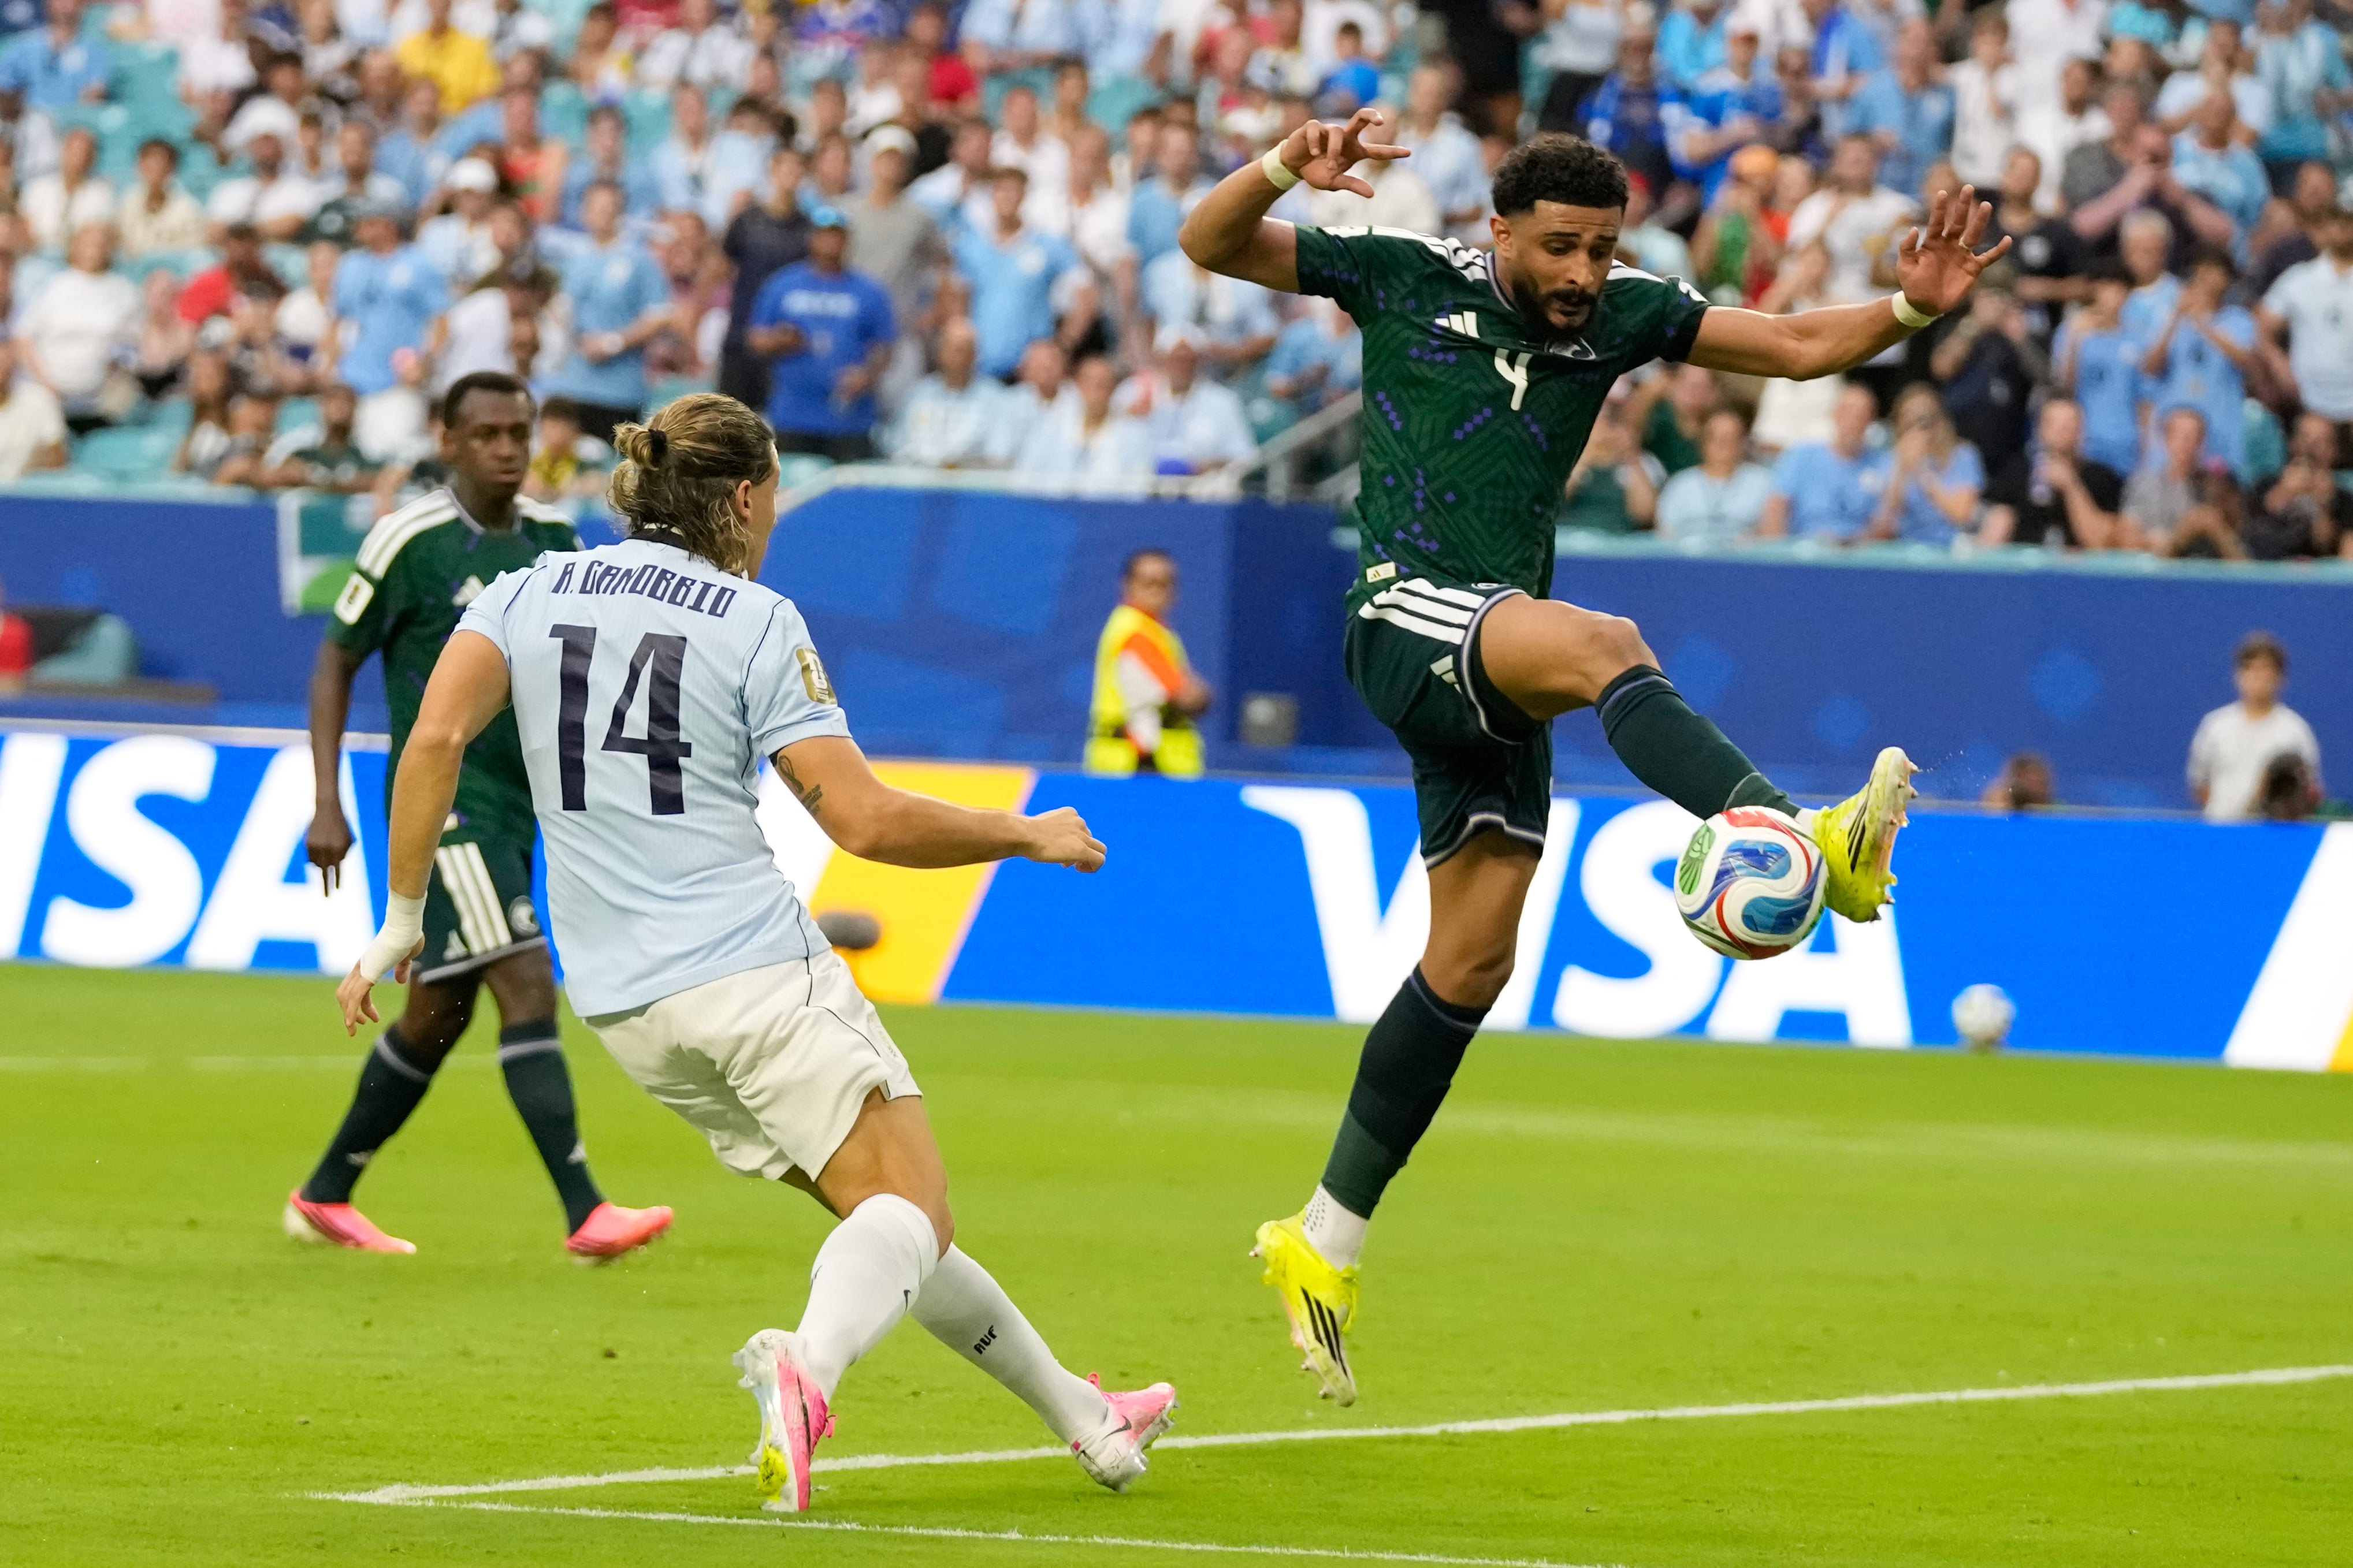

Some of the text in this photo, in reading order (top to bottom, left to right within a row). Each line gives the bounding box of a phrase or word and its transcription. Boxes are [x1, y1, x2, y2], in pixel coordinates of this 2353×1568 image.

[1494, 348, 1533, 411] 4
[548, 624, 692, 815] 14
[1239, 784, 1913, 1050] VISA
[973, 1324, 997, 1355] AUF
